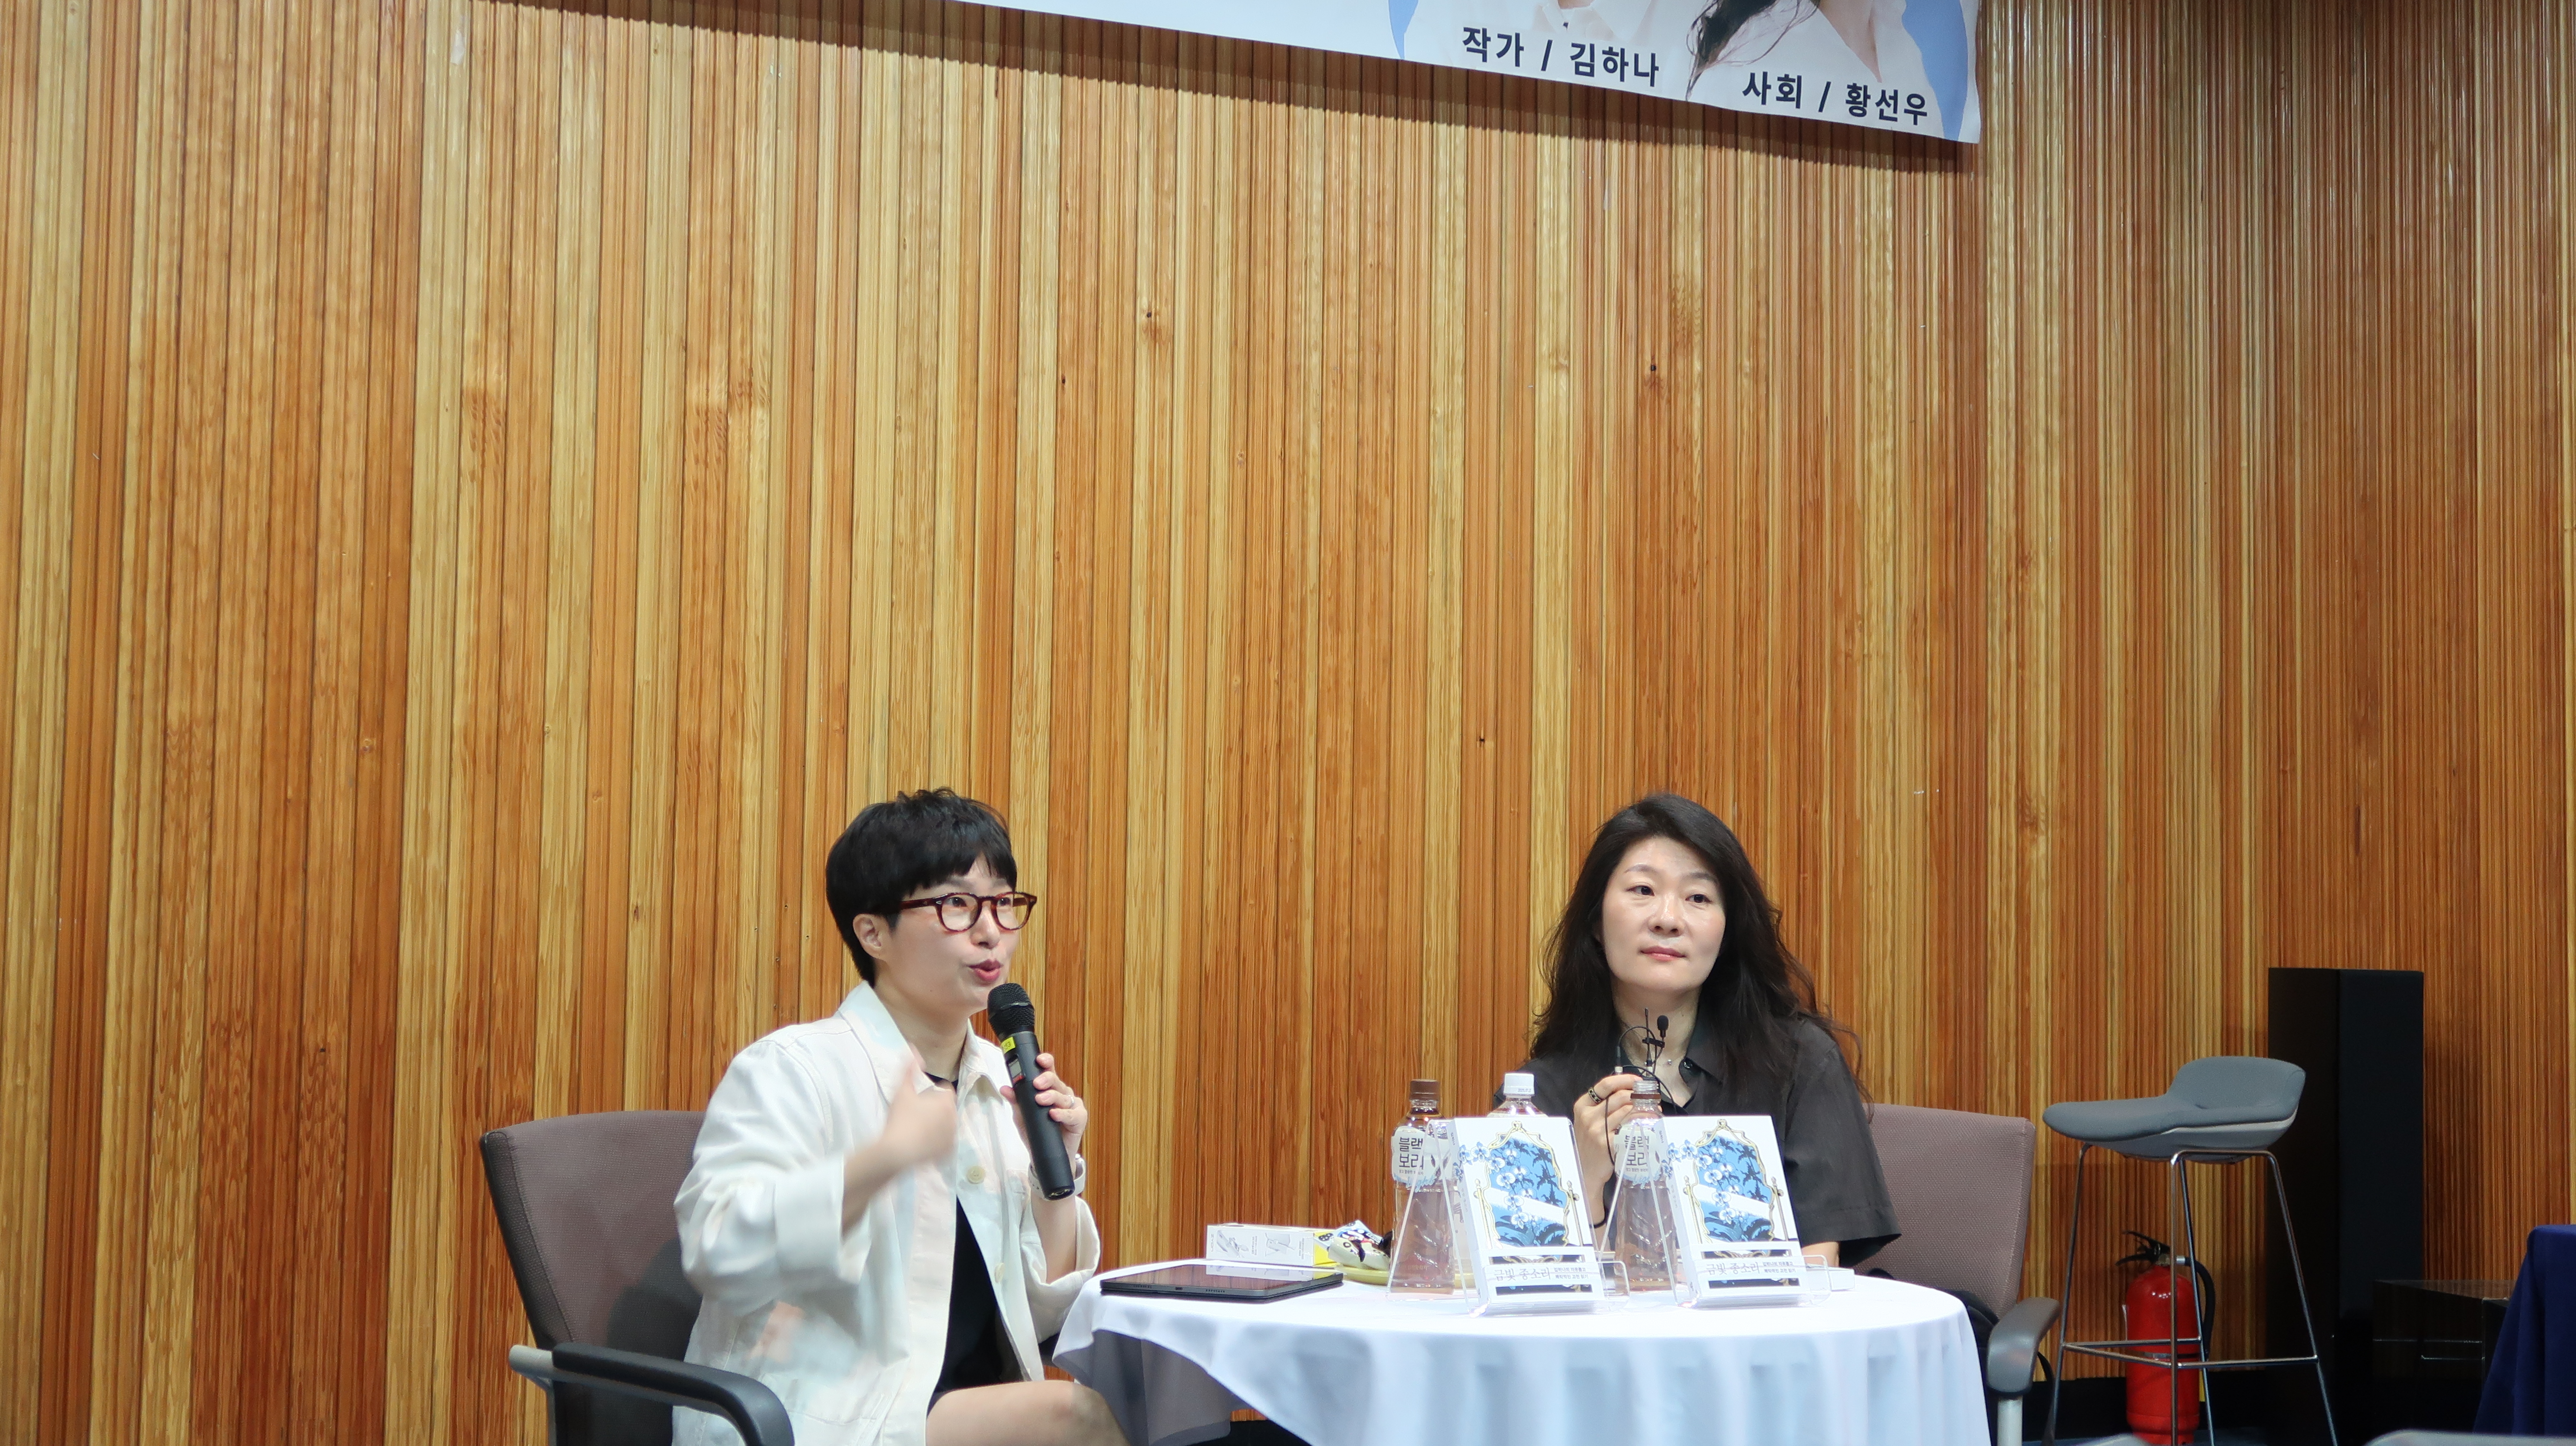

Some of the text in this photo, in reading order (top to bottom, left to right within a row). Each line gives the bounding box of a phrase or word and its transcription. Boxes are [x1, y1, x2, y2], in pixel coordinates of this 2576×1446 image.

[1462, 26, 1659, 87] 작가 / 김하나
[1742, 71, 1928, 126] 사회 / 황선우
[1399, 1137, 1424, 1152] 블랙
[1624, 1134, 1650, 1150] 블랙
[1399, 1153, 1424, 1170] 보리
[1494, 1267, 1551, 1281] 금빛 종소리
[1706, 1261, 1760, 1276] 금빛 종소리
